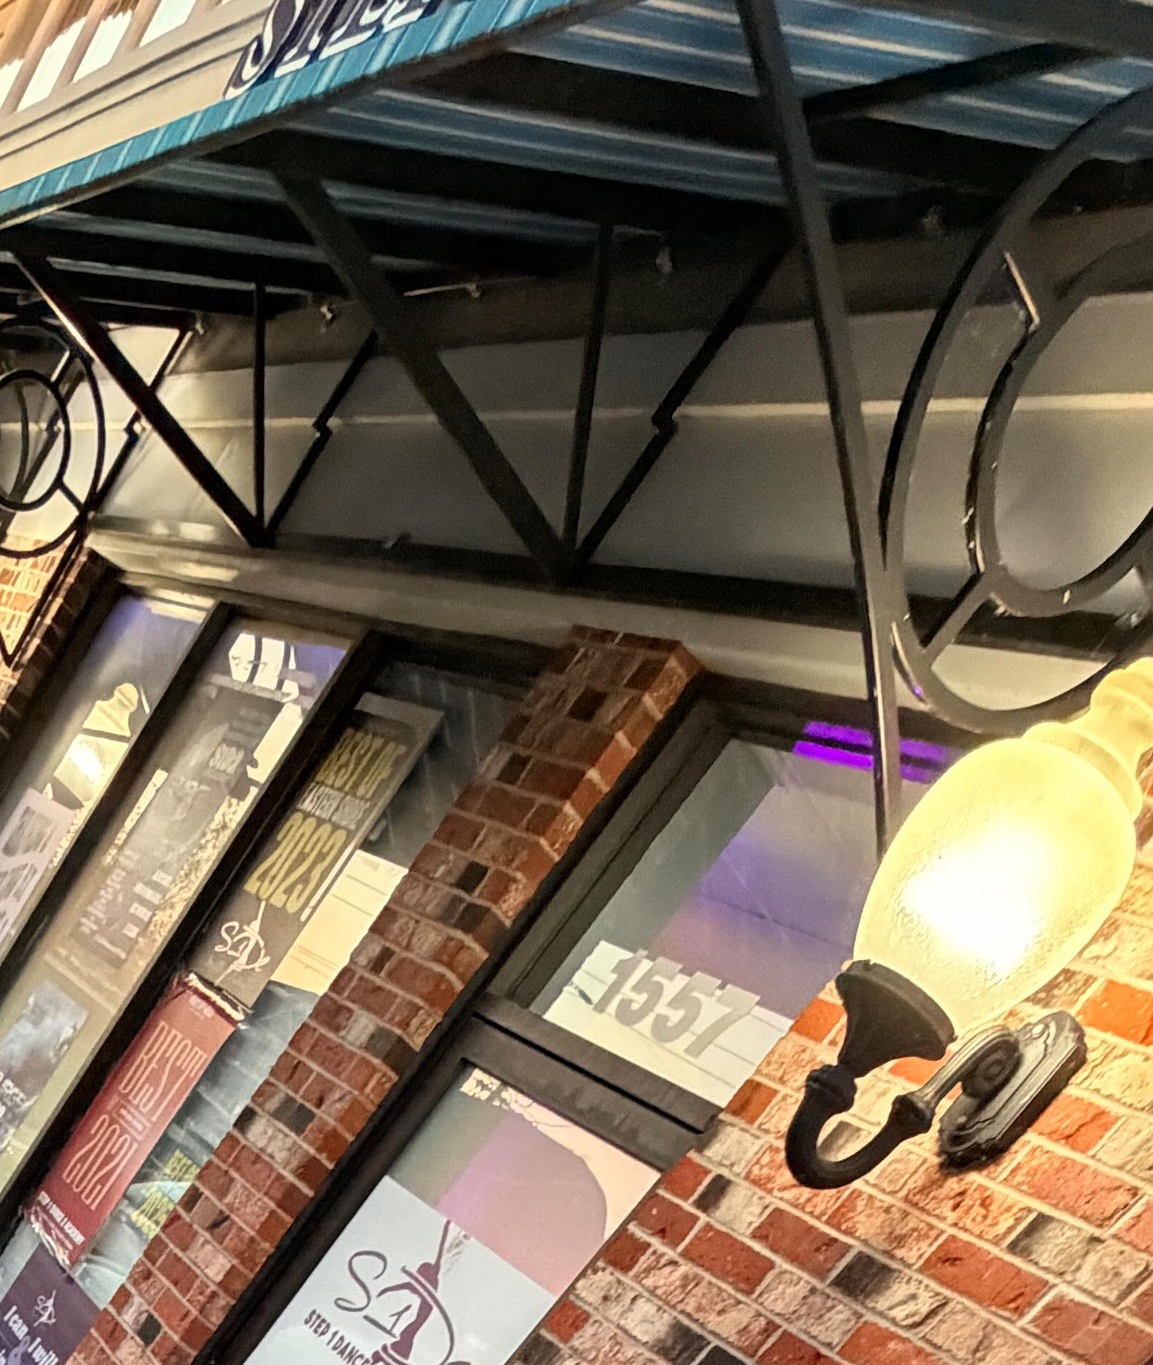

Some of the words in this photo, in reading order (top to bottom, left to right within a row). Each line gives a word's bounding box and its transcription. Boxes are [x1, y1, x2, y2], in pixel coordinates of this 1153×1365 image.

[244, 811, 347, 914] 2023
[592, 948, 761, 1058] 1557
[119, 1020, 208, 1122] BEST
[62, 1114, 138, 1211] 2021
[3, 1305, 17, 1322] I
[8, 1314, 29, 1340] can
[28, 1337, 42, 1353] I
[303, 1309, 329, 1337] STEP
[327, 1330, 338, 1346] 1
